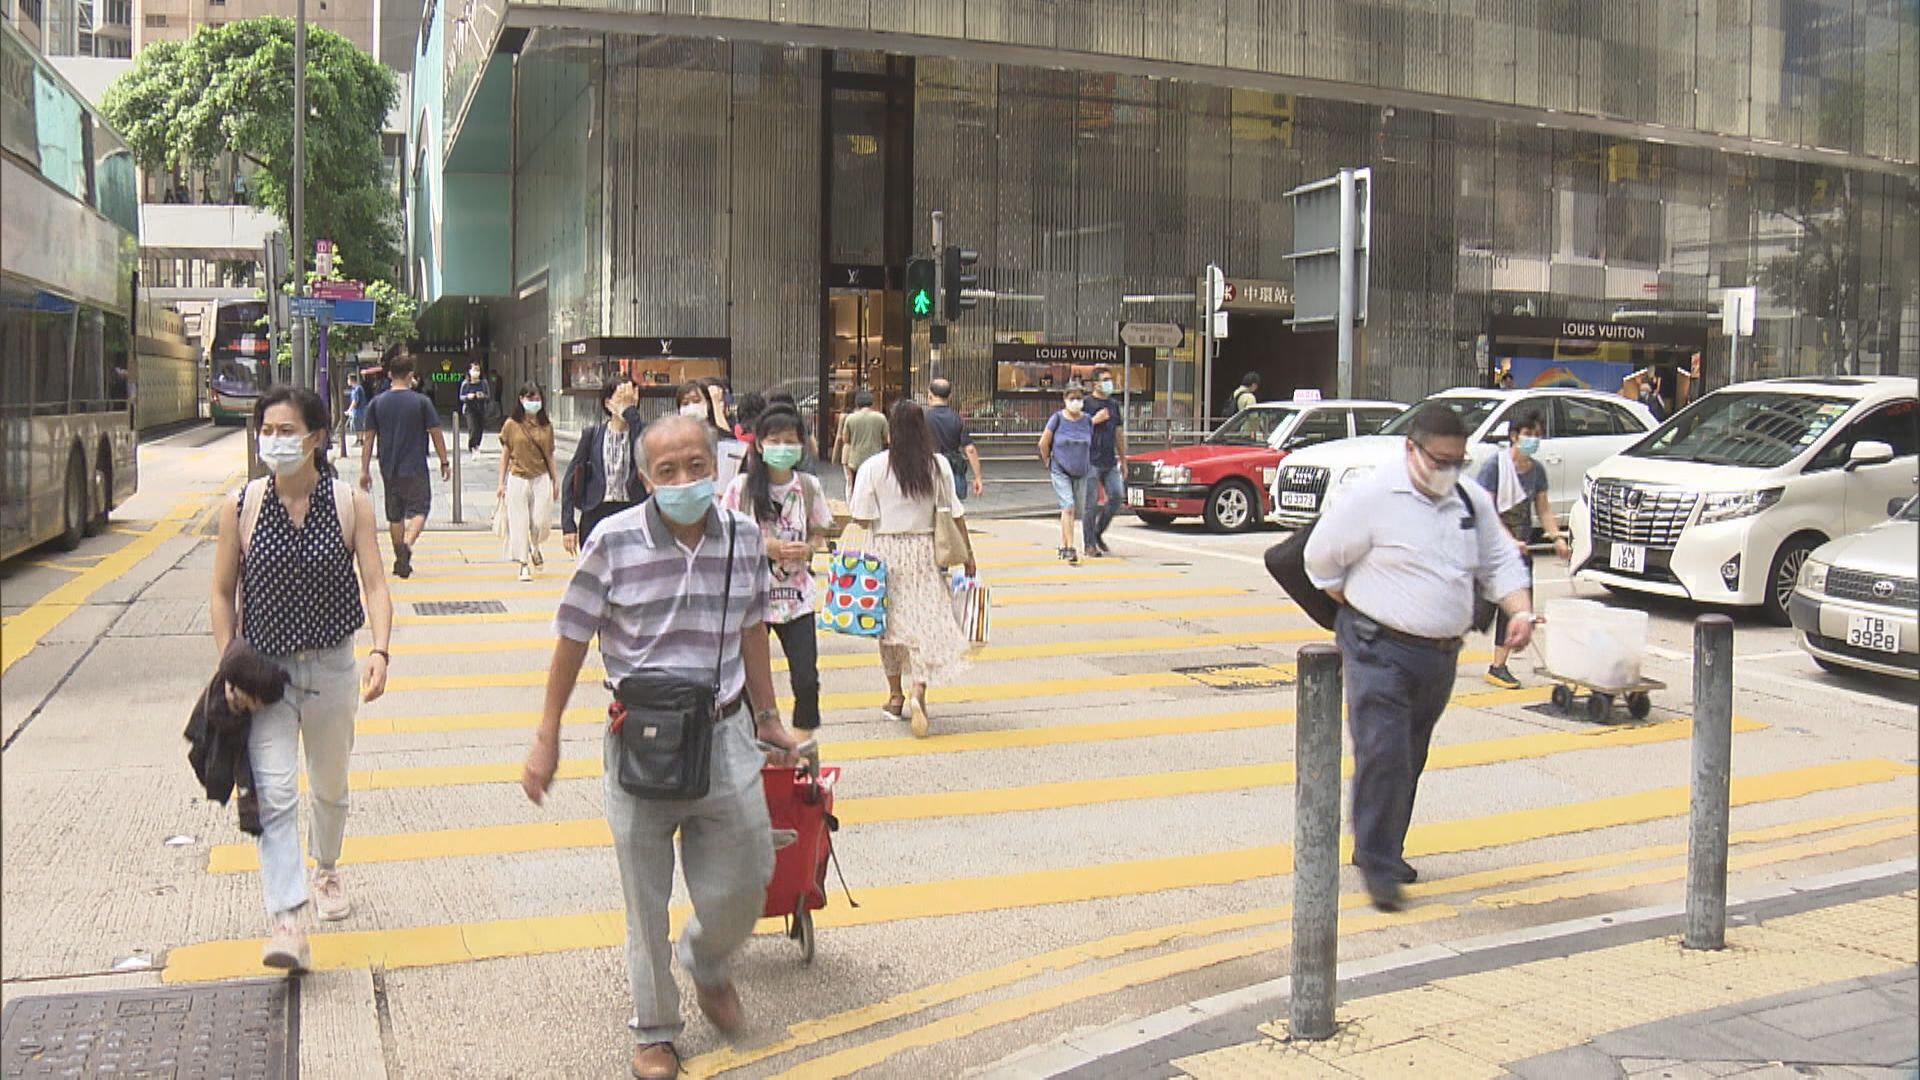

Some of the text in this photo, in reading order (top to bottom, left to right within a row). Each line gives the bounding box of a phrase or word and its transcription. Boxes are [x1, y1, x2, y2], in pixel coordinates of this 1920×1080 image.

[1243, 285, 1288, 304] 中環站
[1562, 322, 1645, 339] LOUIS VUITTON
[1036, 348, 1117, 361] LOUIS VUITTON
[1621, 545, 1635, 558] VN
[1618, 556, 1635, 569] 184
[1864, 617, 1884, 632] TB
[1851, 629, 1895, 650] 3928
